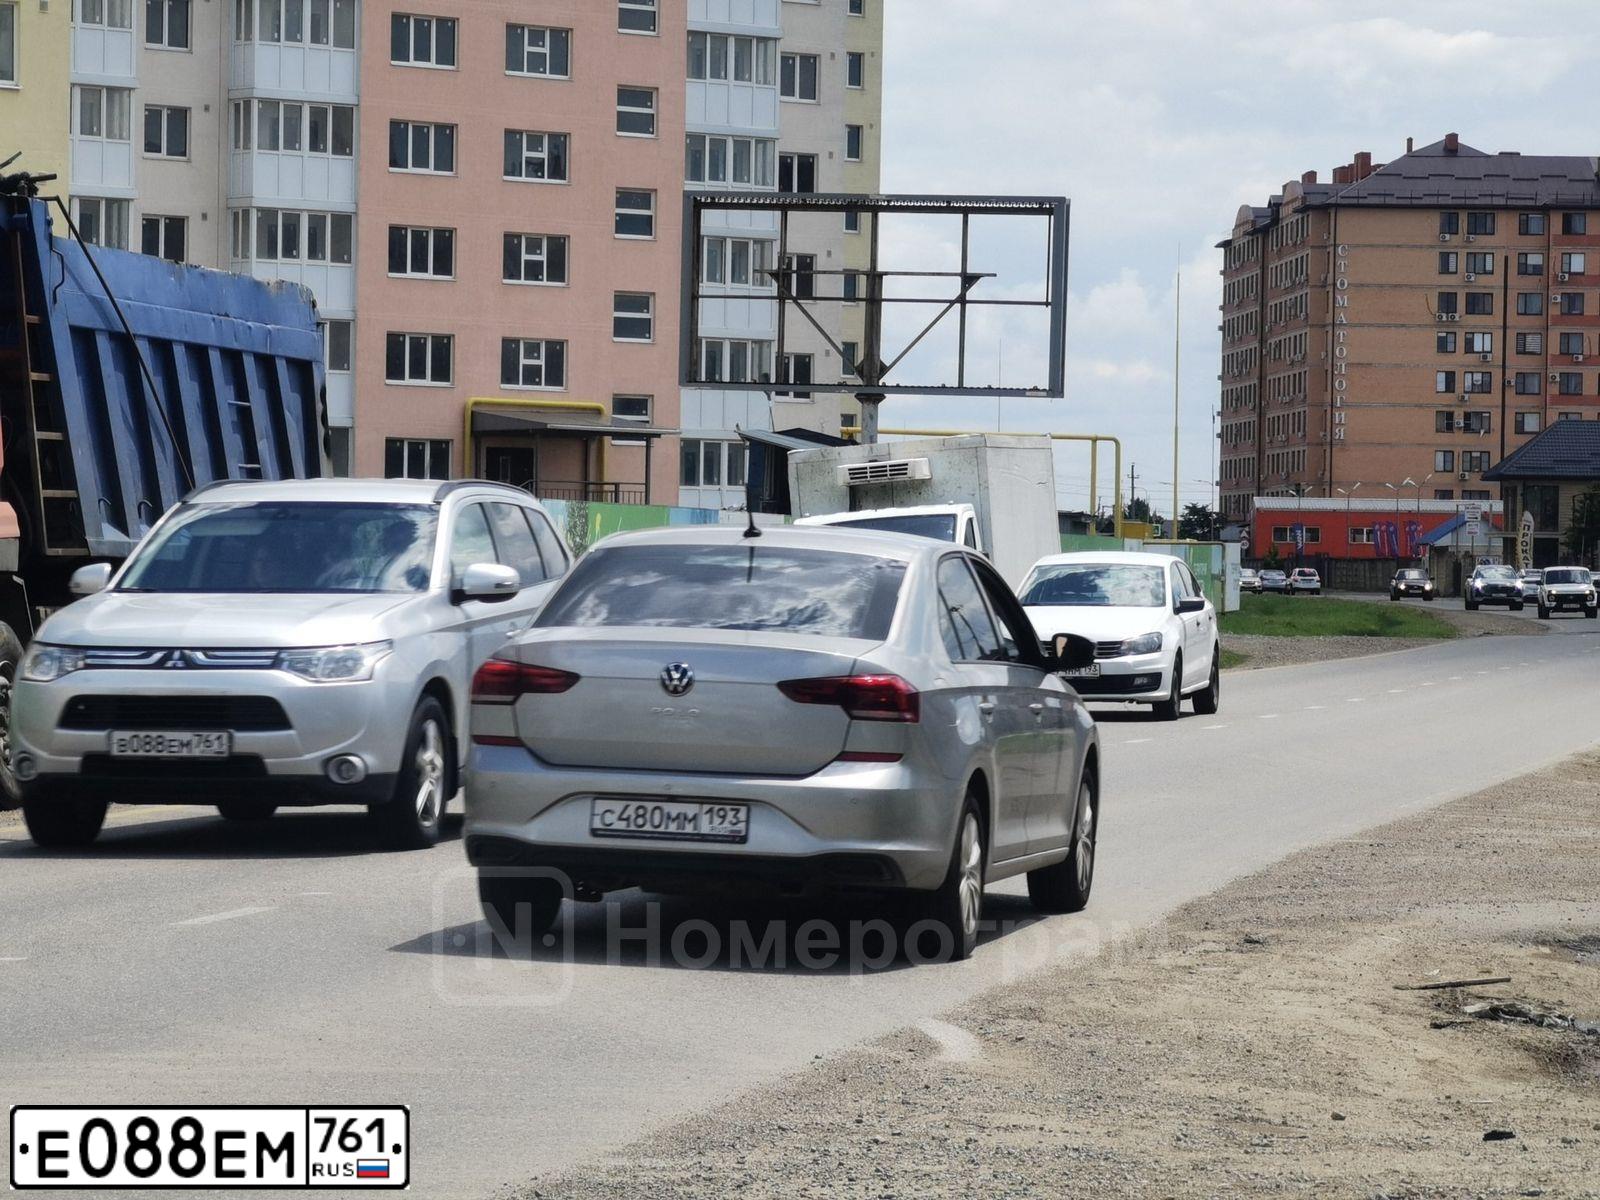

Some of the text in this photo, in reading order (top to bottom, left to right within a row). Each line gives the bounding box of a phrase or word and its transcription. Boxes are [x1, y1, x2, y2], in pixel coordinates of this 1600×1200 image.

[1334, 244, 1348, 439] СТОМАТОЛОГИЯ
[1520, 524, 1530, 568] ПРОКАТ
[600, 804, 742, 832] С480ММ 193
